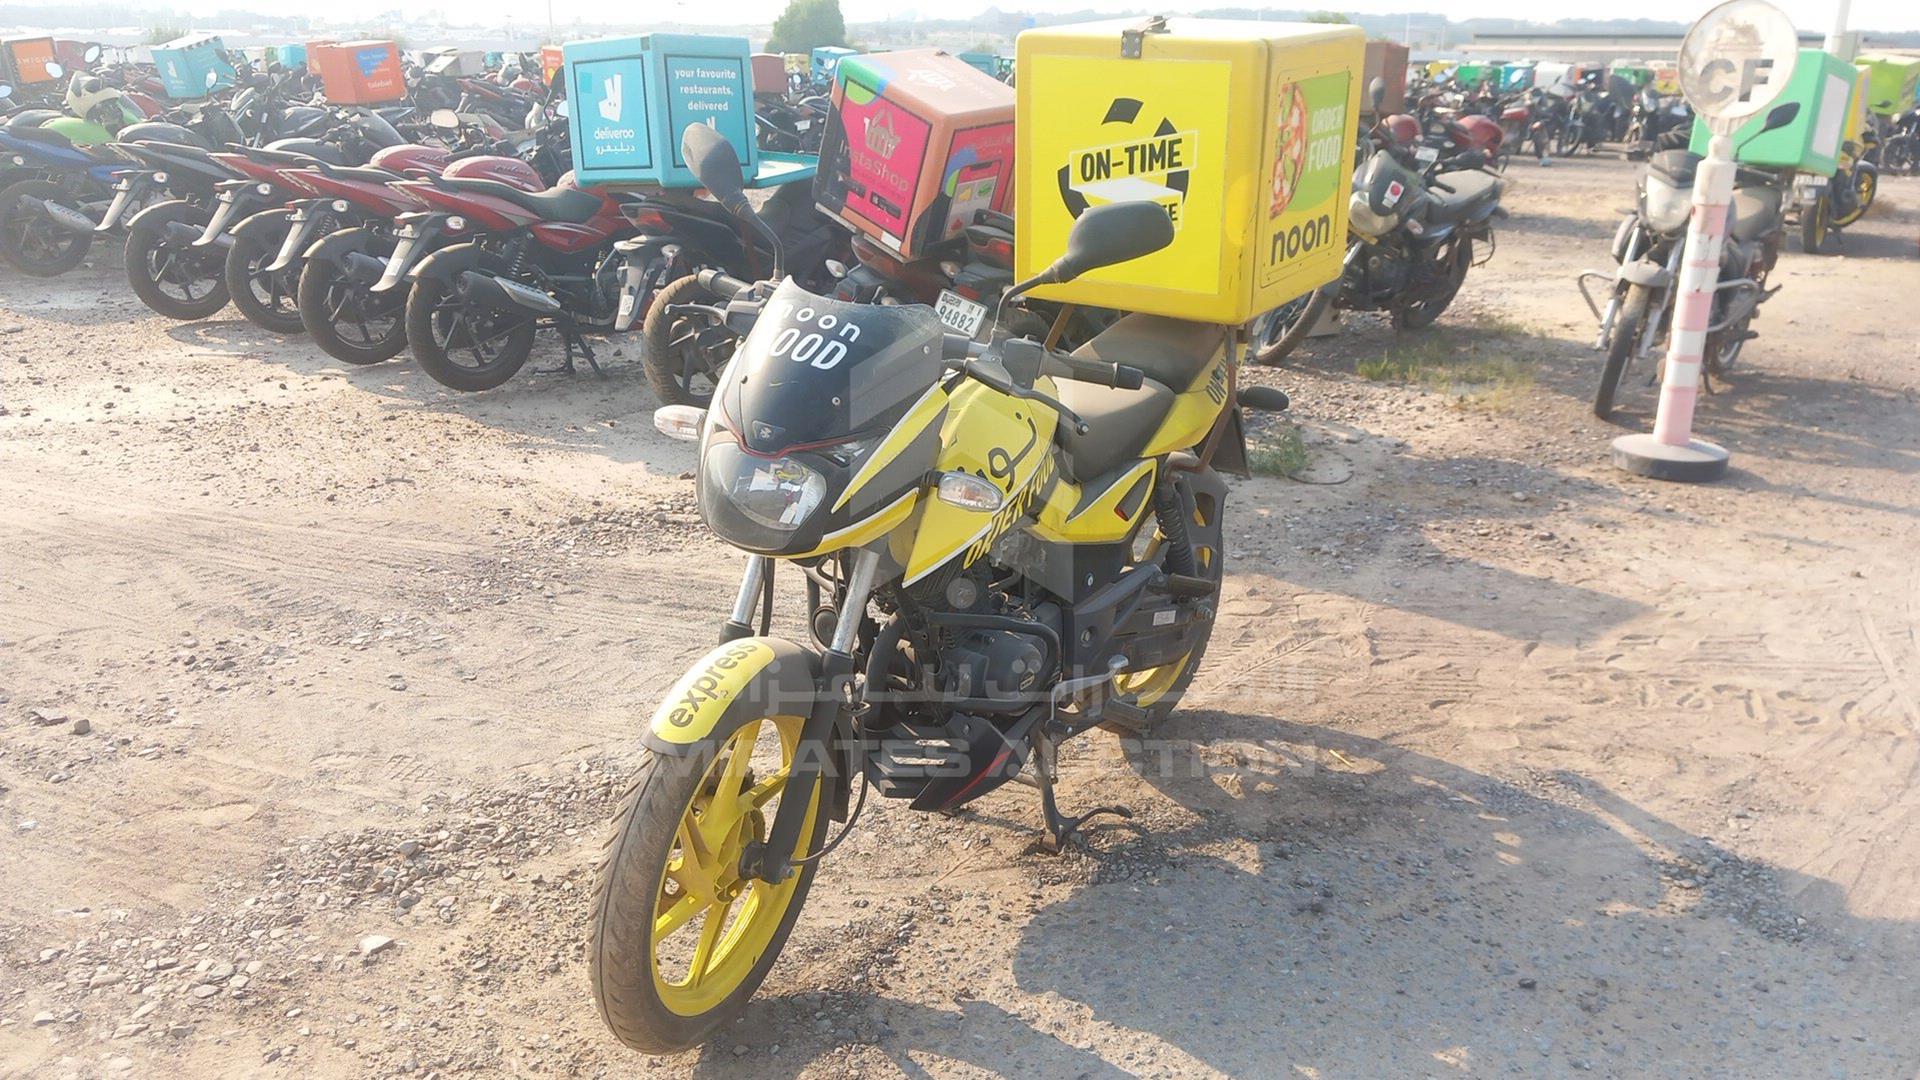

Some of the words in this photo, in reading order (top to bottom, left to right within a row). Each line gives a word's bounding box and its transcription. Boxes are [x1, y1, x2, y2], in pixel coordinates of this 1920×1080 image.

[674, 69, 694, 80] your
[696, 67, 736, 79] favourite
[680, 84, 734, 96] restaurants,
[1698, 58, 1775, 105] CF
[687, 100, 729, 111] delivered
[1311, 103, 1345, 136] ORDER
[593, 126, 635, 140] deliveroo
[1081, 137, 1183, 182] ON-TIME
[1307, 134, 1342, 173] FOOD
[1270, 213, 1331, 266] noon
[939, 304, 976, 333] 94882
[767, 327, 848, 371] OOD
[668, 642, 759, 728] express
